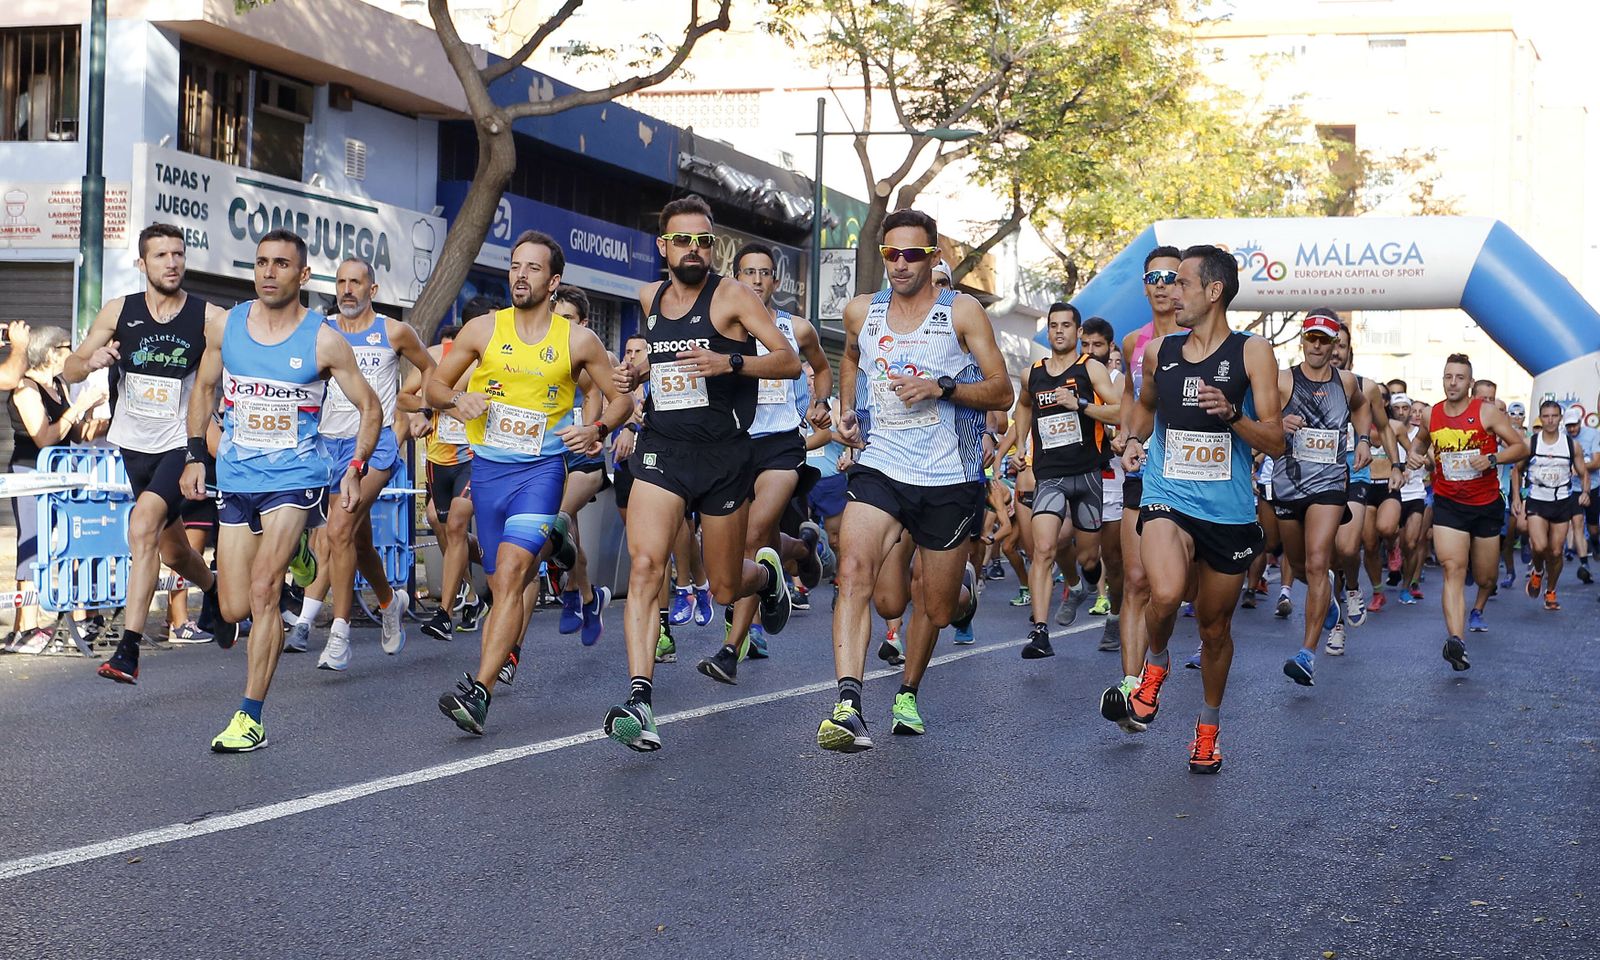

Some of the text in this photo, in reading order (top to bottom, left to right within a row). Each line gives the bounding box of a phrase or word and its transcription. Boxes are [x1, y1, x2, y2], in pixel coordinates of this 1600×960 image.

[155, 163, 210, 193] TAPAS Y
[155, 193, 209, 221] JUEGOS
[181, 227, 209, 250] ESA
[228, 197, 391, 272] COMEJUEGA
[569, 228, 629, 264] GRUPOGUIA
[1295, 238, 1425, 266] MÁLAGA
[1294, 269, 1425, 278] EUROPEAN CAPITAL OF SPORT
[1257, 287, 1386, 296] www.malaga2020.eu
[144, 334, 191, 349] Atletismo
[653, 338, 710, 354] BESOCCER
[143, 387, 169, 403] 45
[484, 387, 506, 397] Vopak
[248, 413, 292, 431] 585
[499, 418, 540, 439] 684
[1049, 421, 1077, 435] 325
[1305, 437, 1335, 450] 304
[1182, 444, 1226, 463] 706
